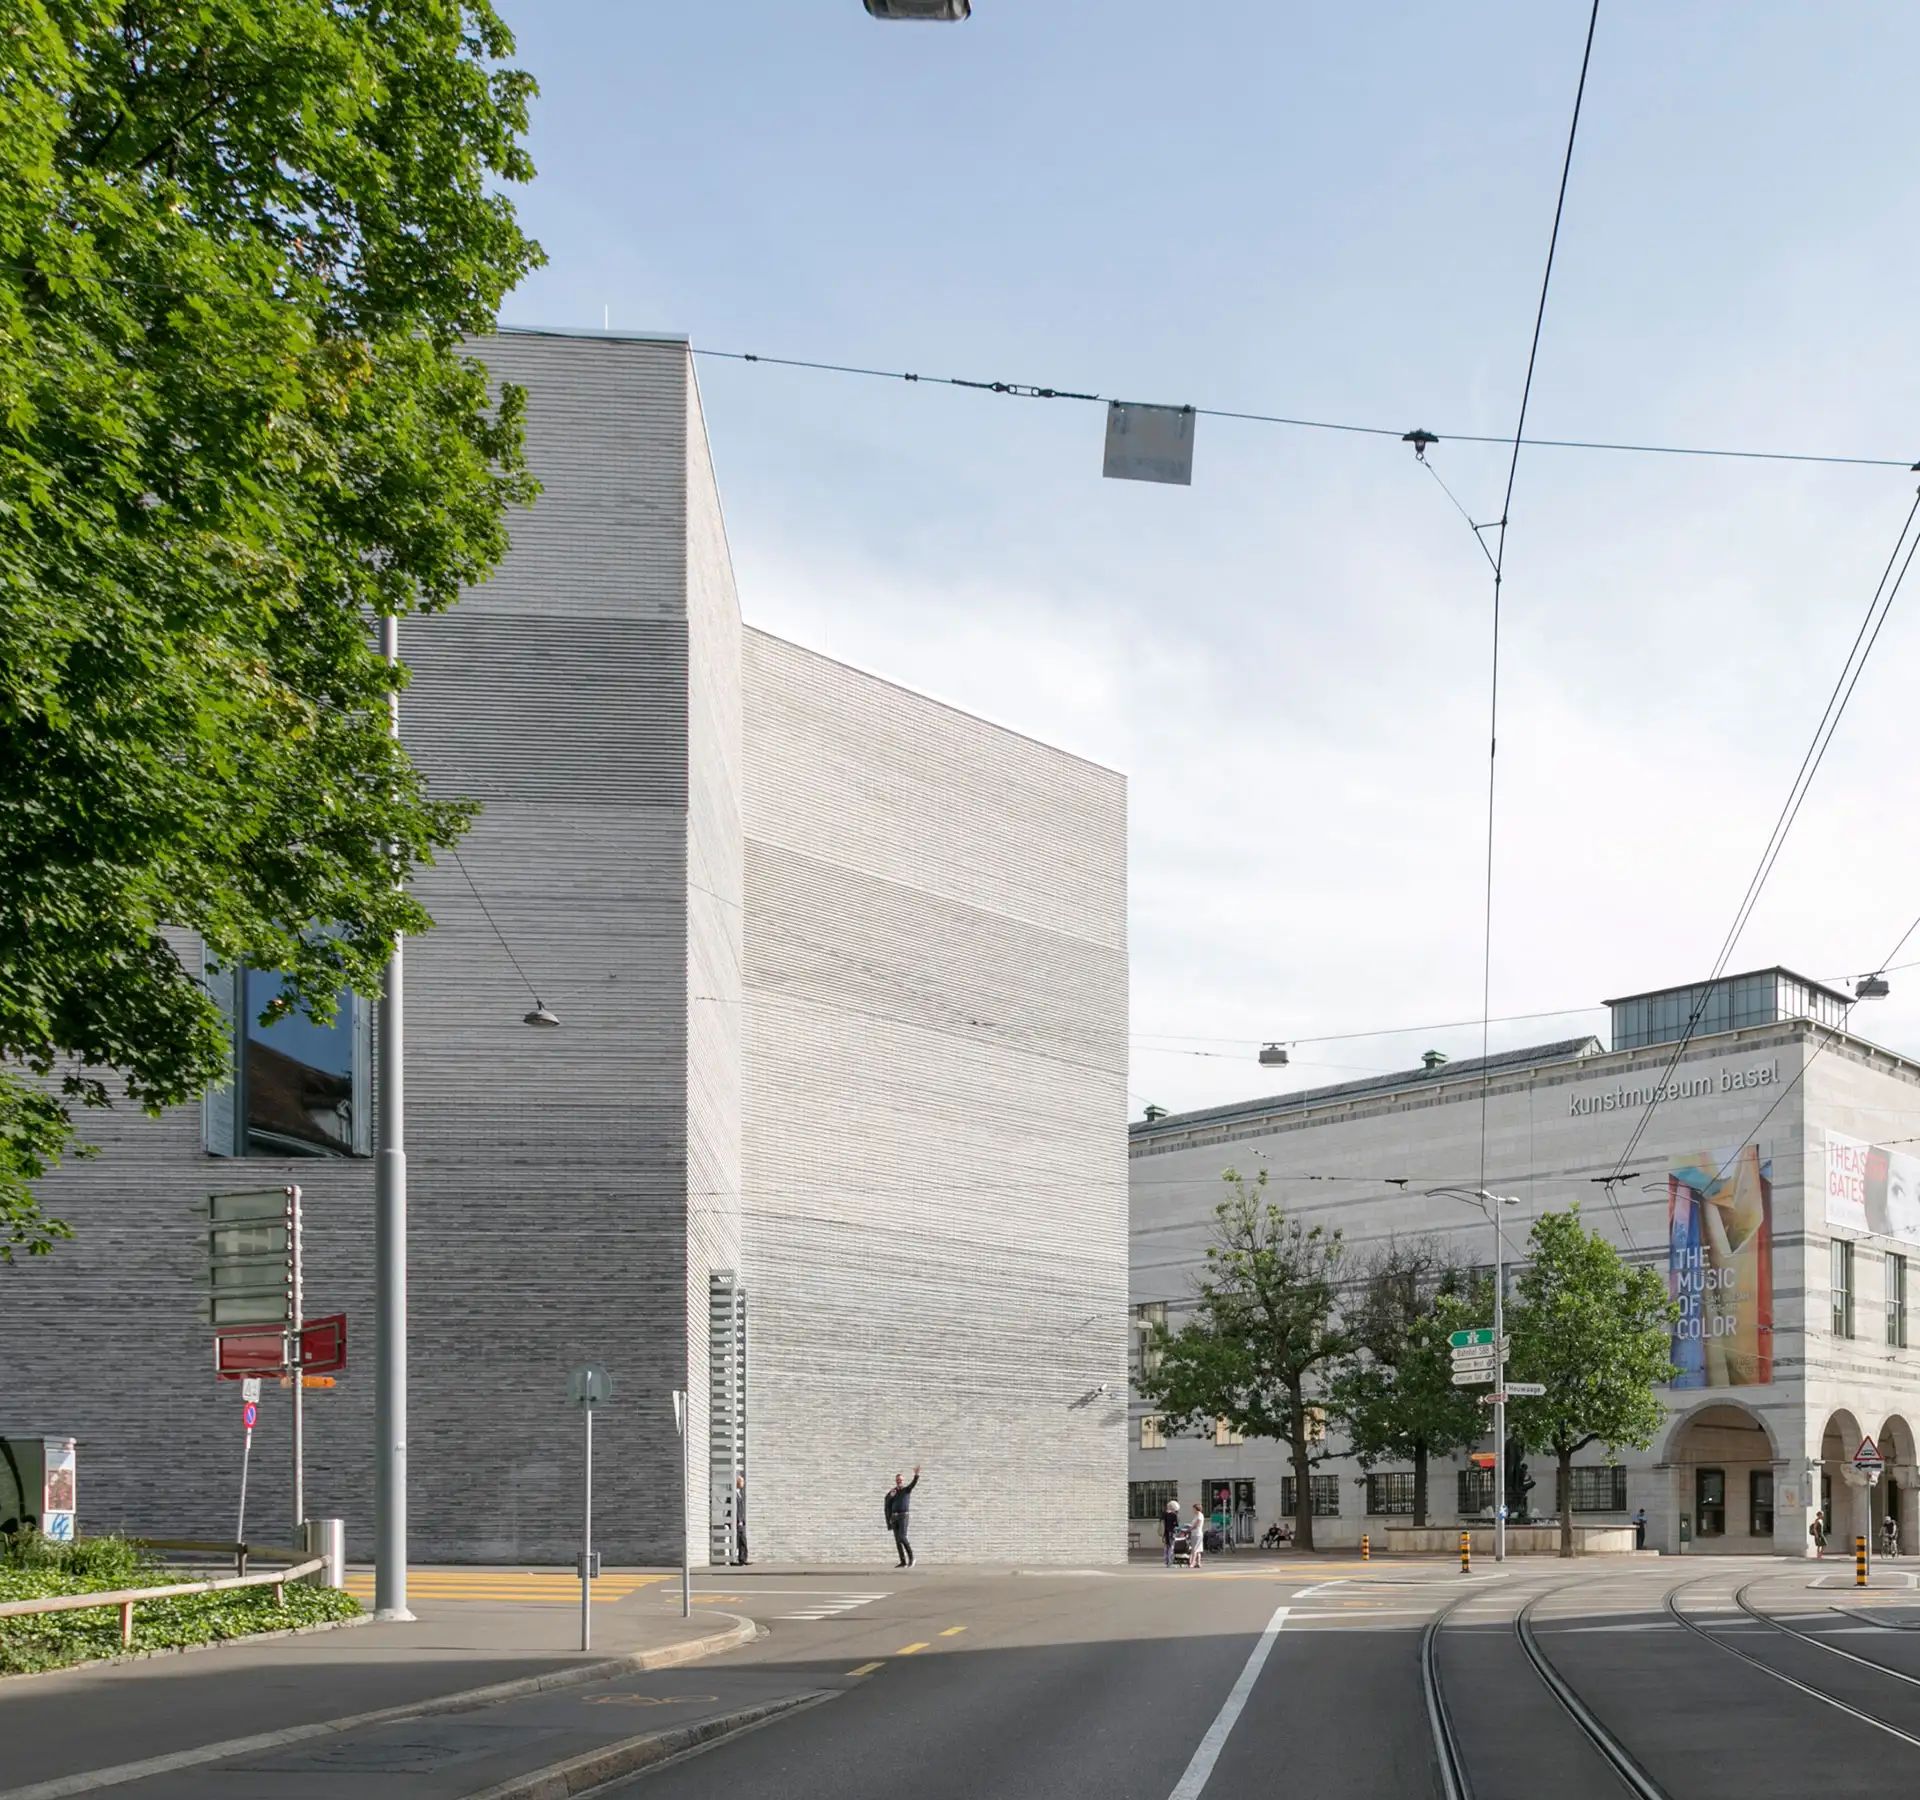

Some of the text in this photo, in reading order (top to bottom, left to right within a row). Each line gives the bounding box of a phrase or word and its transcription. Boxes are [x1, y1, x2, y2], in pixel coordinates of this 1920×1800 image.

[1569, 1058, 1779, 1116] kunstmuseum basel
[1676, 1245, 1711, 1269] THE
[1677, 1267, 1735, 1293] MUSIC
[1677, 1294, 1701, 1316] OF
[1677, 1316, 1737, 1339] COLOR
